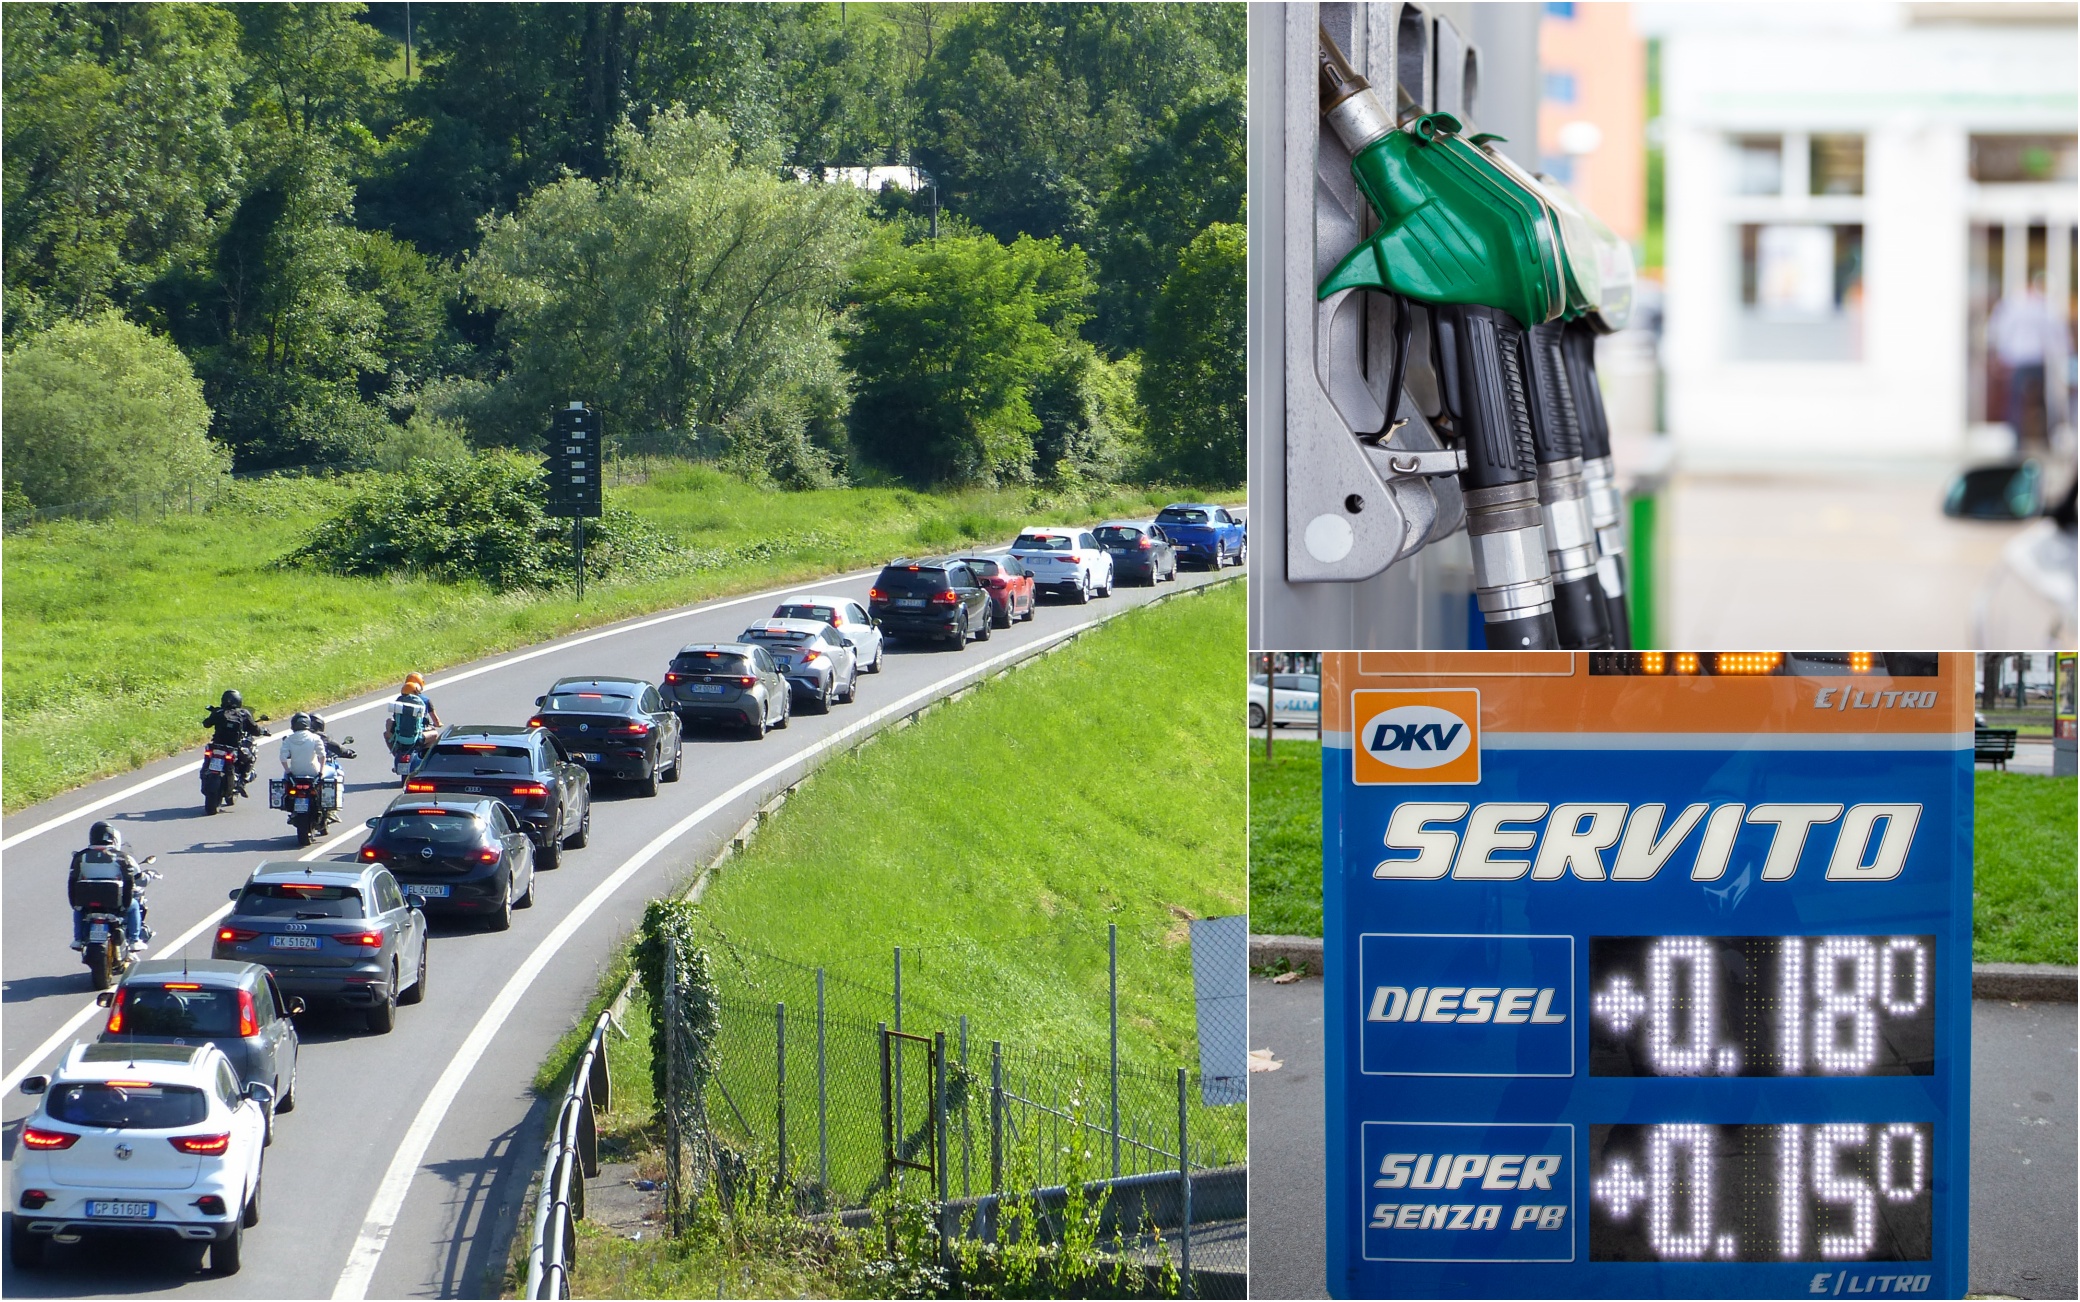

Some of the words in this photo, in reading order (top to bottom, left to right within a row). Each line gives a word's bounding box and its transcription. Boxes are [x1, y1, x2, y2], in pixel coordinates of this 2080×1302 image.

[1370, 723, 1464, 752] DKV
[1372, 802, 1923, 881] SERVITO
[408, 885, 418, 895] EL
[288, 937, 316, 948] 516ZN
[1367, 986, 1567, 1025] DIESEL
[1373, 1154, 1562, 1191] SUPER
[112, 1202, 148, 1216] 616DE
[1368, 1204, 1502, 1231] SENZA
[1510, 1204, 1568, 1231] PB
